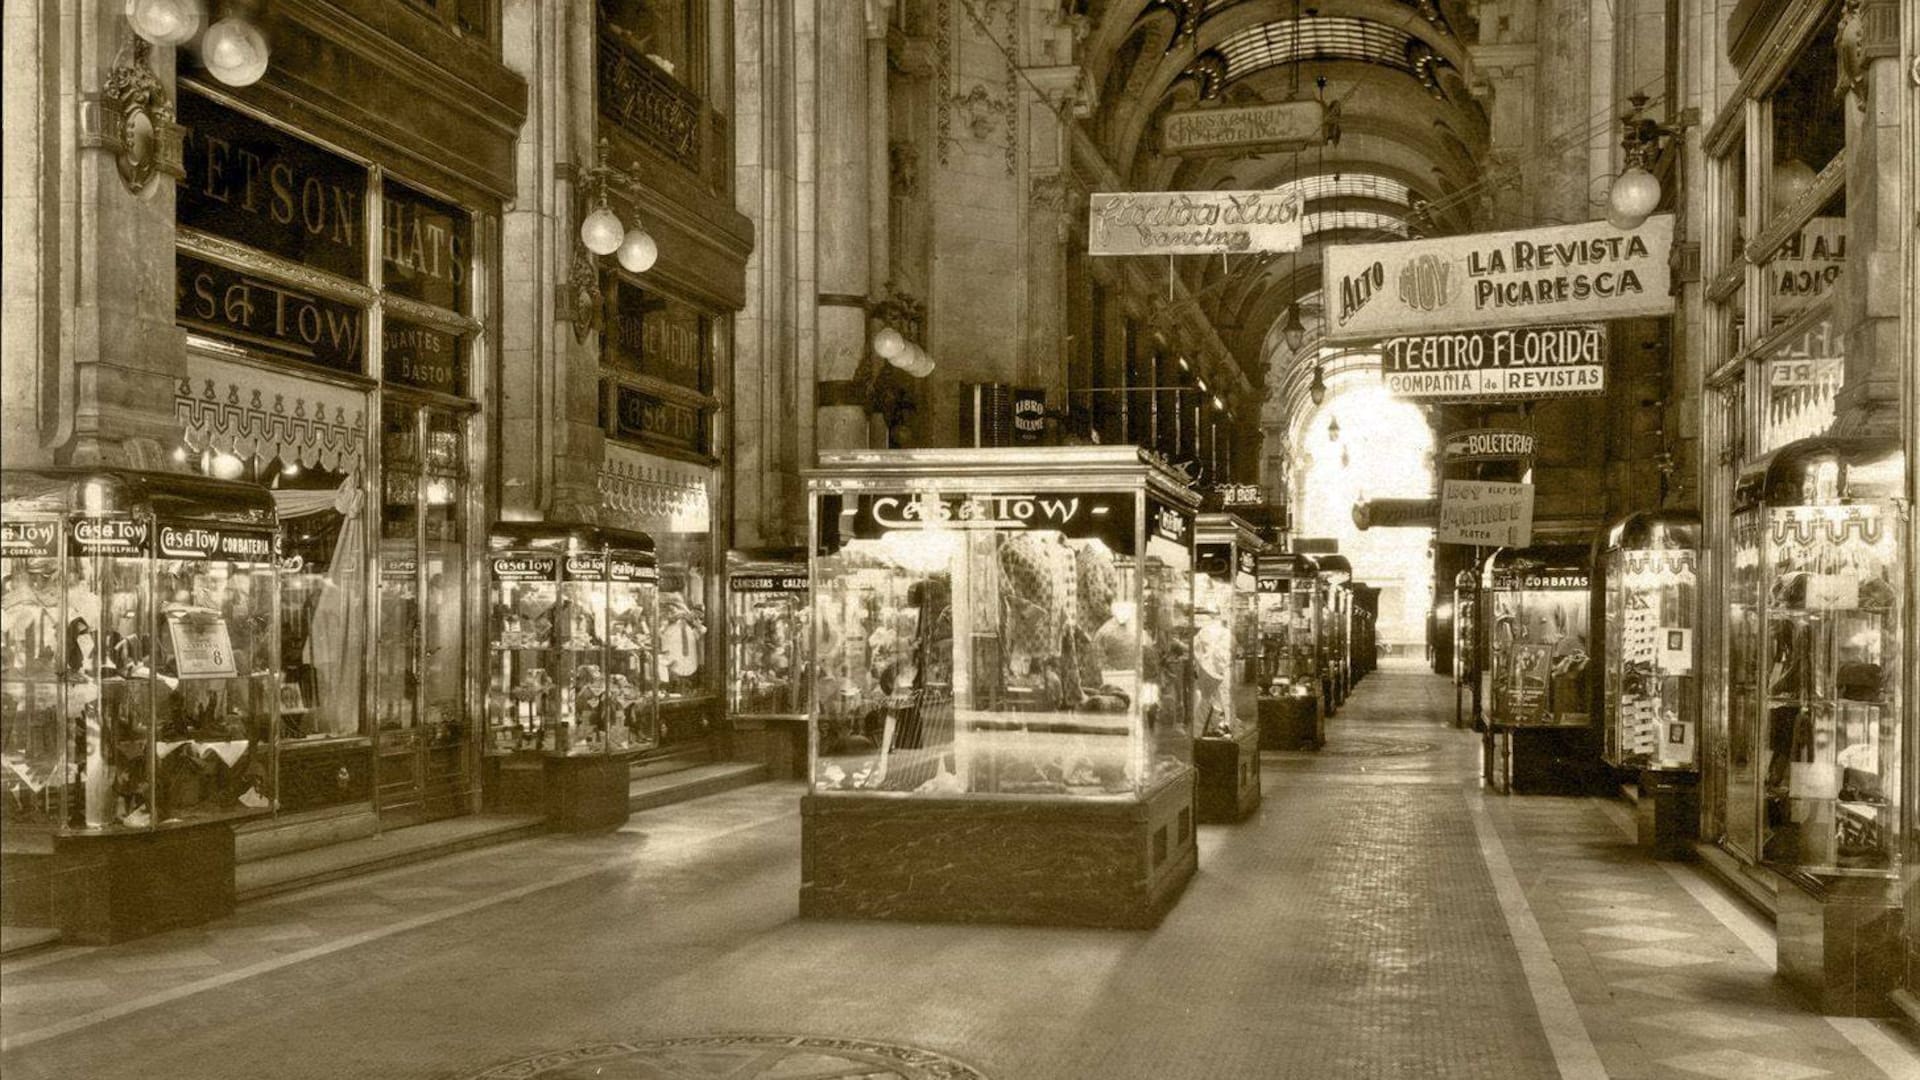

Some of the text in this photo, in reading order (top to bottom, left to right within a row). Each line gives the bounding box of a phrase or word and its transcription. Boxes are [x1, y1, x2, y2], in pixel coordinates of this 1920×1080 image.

[382, 197, 465, 286] HATS
[1467, 235, 1649, 277] LA REVISTA
[1339, 260, 1385, 327] ALTO
[1400, 254, 1450, 311] HOY
[1475, 269, 1644, 310] PICARESCA
[1387, 328, 1602, 371] TEATRO FLORIDA
[1508, 369, 1600, 390] REVISTAS
[1015, 399, 1044, 415] LIBRO
[1468, 433, 1534, 455] BOLETERIA
[872, 496, 1079, 530] Casa Tow
[74, 520, 147, 545] Casa Tow
[160, 527, 196, 557] Casa
[189, 529, 220, 553] Tow
[222, 537, 270, 555] CORBATERIA
[82, 546, 140, 554] PHILADELPHIA
[1525, 576, 1589, 587] CORBATAS
